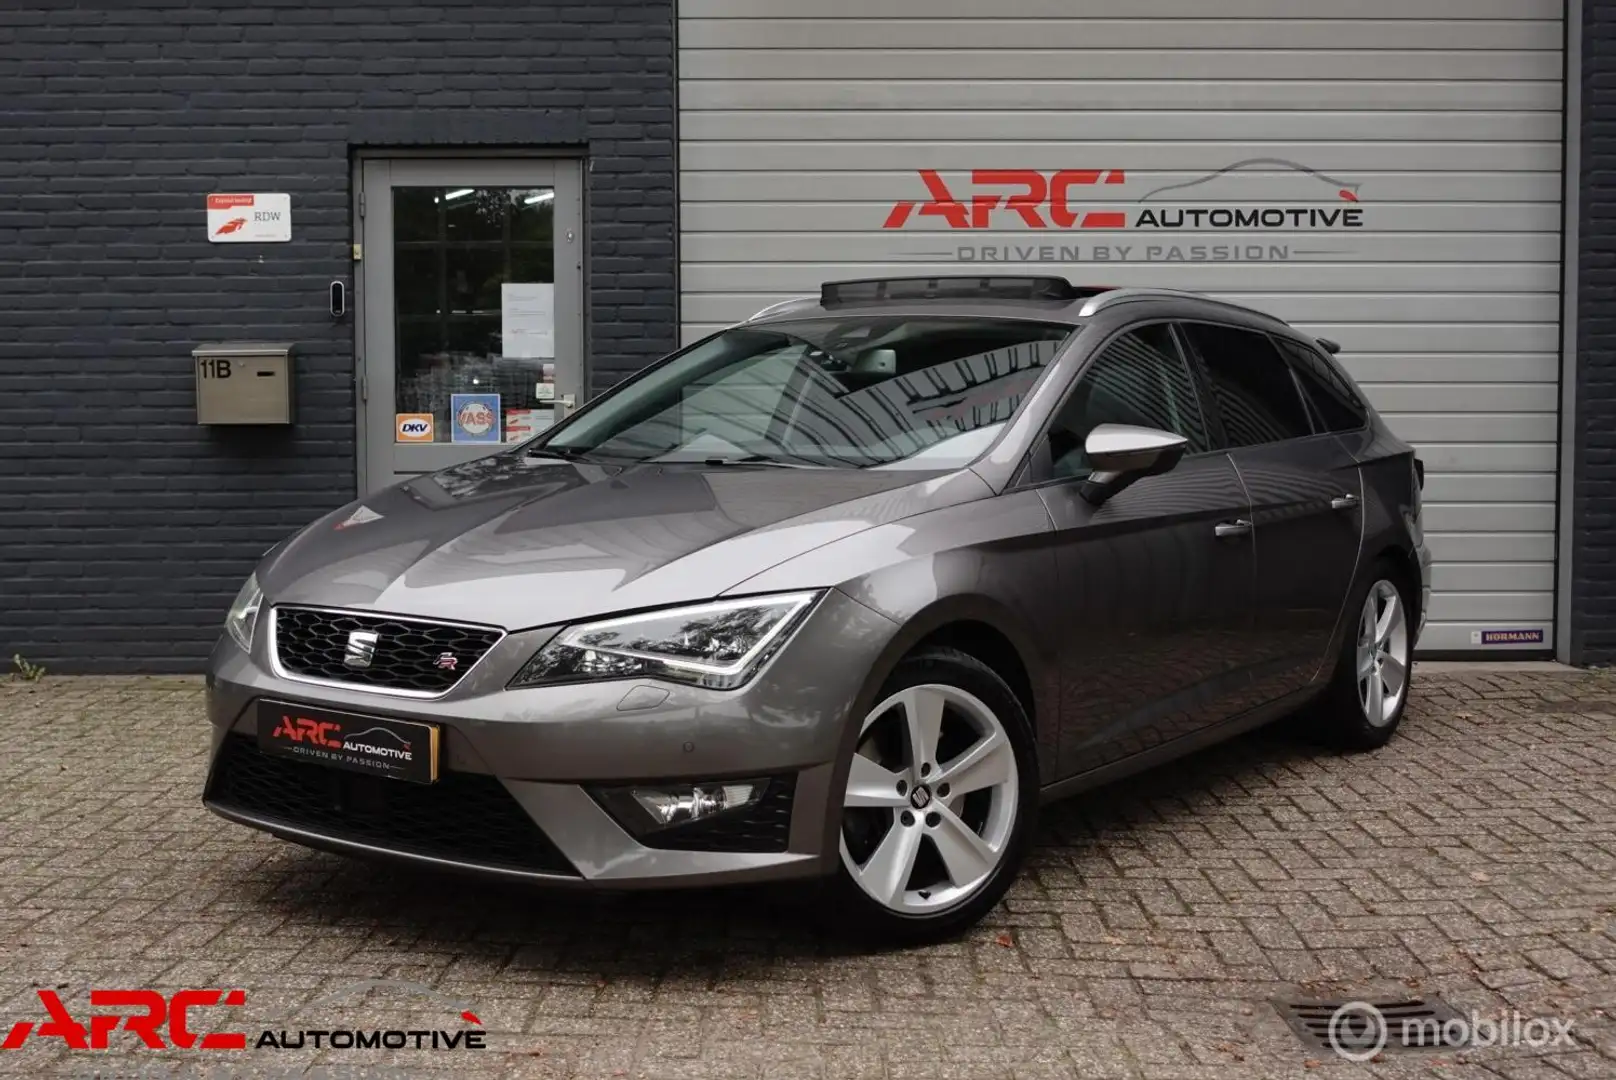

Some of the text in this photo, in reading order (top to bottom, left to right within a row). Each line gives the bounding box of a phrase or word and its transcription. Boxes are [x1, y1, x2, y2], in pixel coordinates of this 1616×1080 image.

[883, 169, 1363, 228] ARC AUTOMOTIVE
[254, 211, 281, 222] RDW
[957, 244, 1289, 261] DRIVEN BY PASSION
[200, 359, 232, 379] 11B
[402, 423, 428, 433] DKV
[272, 716, 413, 761] ARC AUTOMOTIVE
[293, 746, 391, 770] DRIVEN BY PASSION
